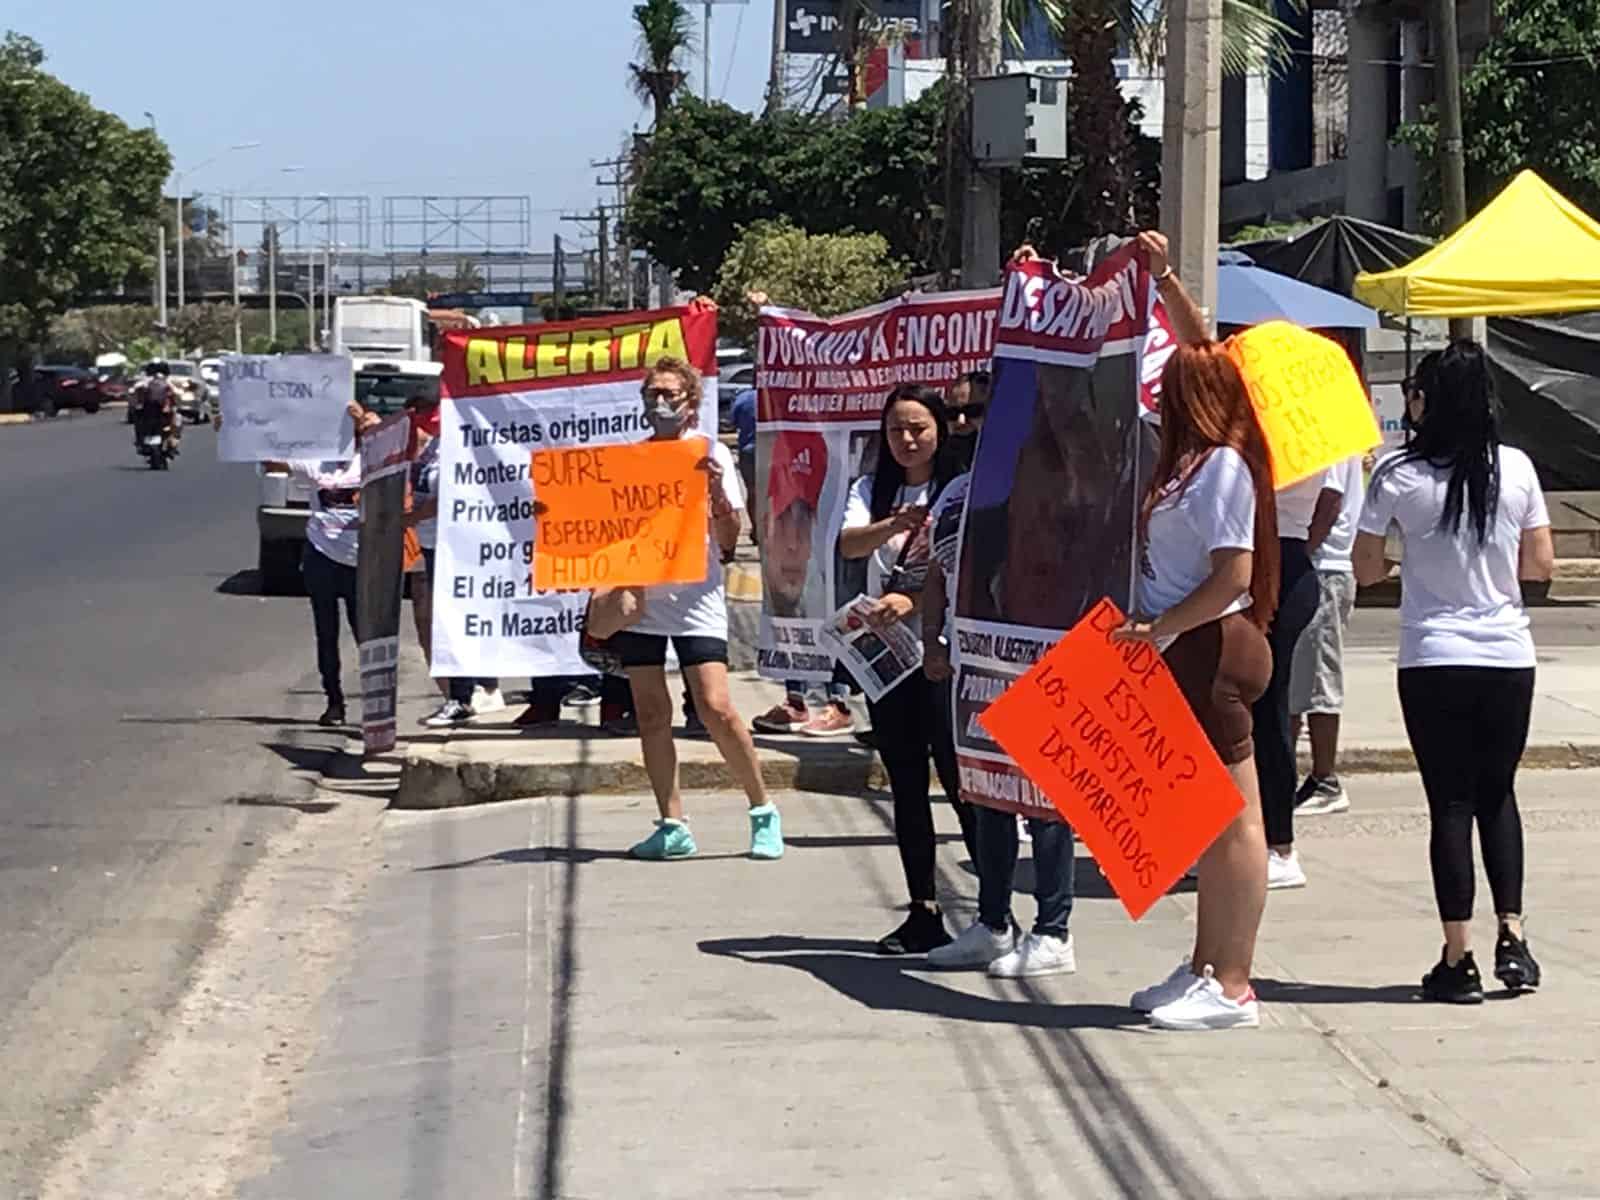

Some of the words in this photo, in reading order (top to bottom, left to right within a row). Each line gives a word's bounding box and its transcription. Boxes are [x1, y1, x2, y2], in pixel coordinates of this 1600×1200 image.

[466, 318, 688, 386] ALERTA
[871, 320, 891, 363] A
[894, 309, 997, 358] ENCONT
[267, 381, 313, 399] ESTAN
[459, 420, 543, 449] Turistas
[532, 448, 612, 487] SUFRE
[611, 479, 684, 513] MADRE
[541, 517, 649, 546] ESPERANDO
[479, 541, 517, 566] por
[523, 540, 534, 566] g
[551, 554, 610, 584] HIJO
[626, 543, 640, 565] A
[652, 539, 680, 561] SU
[453, 575, 474, 599] El
[464, 613, 493, 637] En
[501, 606, 588, 637] Mazatlá
[1034, 664, 1069, 709] LOS
[1070, 699, 1154, 818] TURISTAS
[1103, 677, 1175, 772] ESTAN
[1168, 754, 1198, 790] ?
[1037, 725, 1160, 889] DESAPARECIDOS
